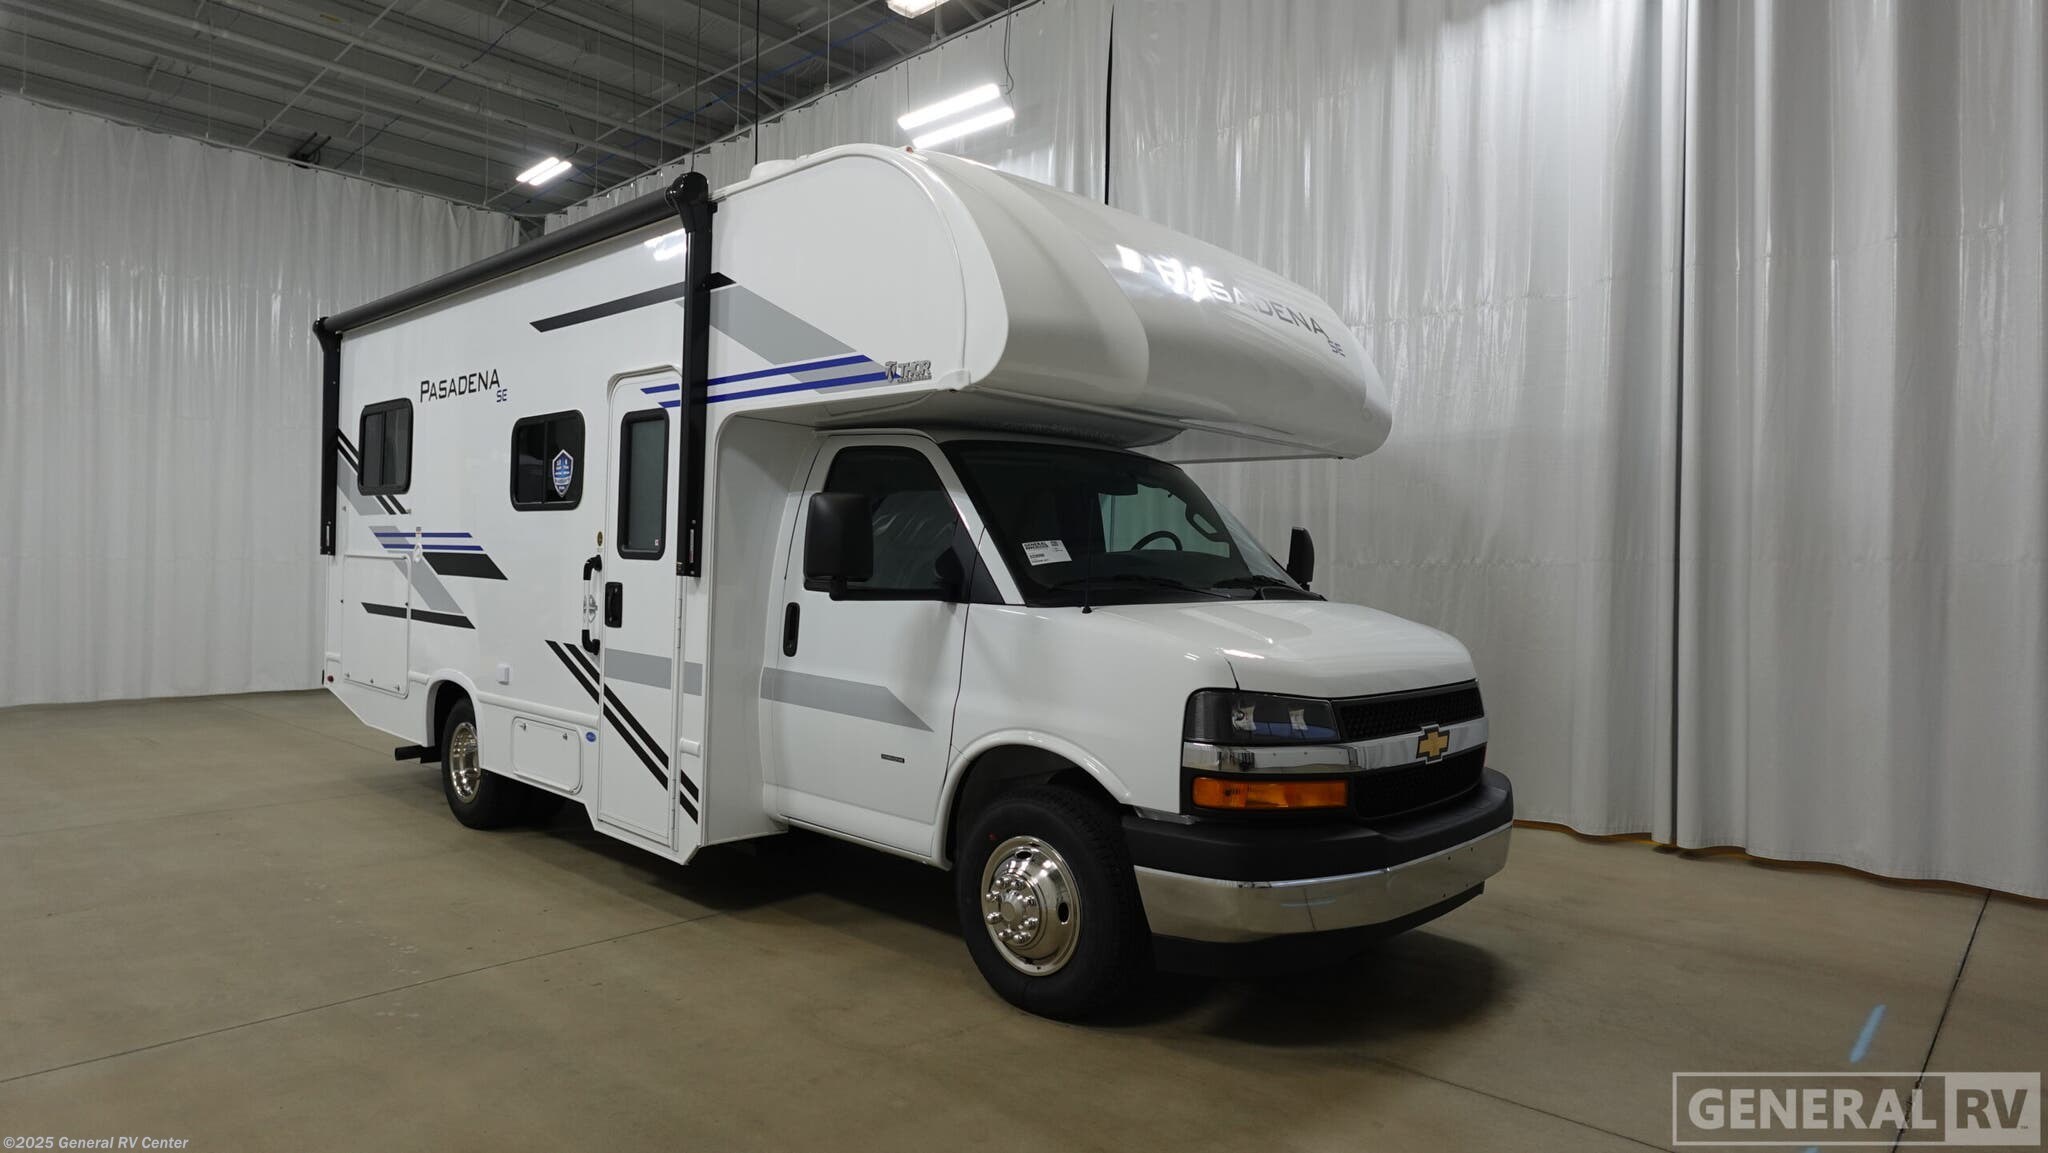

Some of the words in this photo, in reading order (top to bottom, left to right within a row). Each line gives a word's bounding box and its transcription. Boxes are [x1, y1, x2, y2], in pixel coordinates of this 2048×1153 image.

[897, 359, 932, 379] THOR
[419, 368, 501, 403] PASADENA
[496, 388, 508, 403] SE
